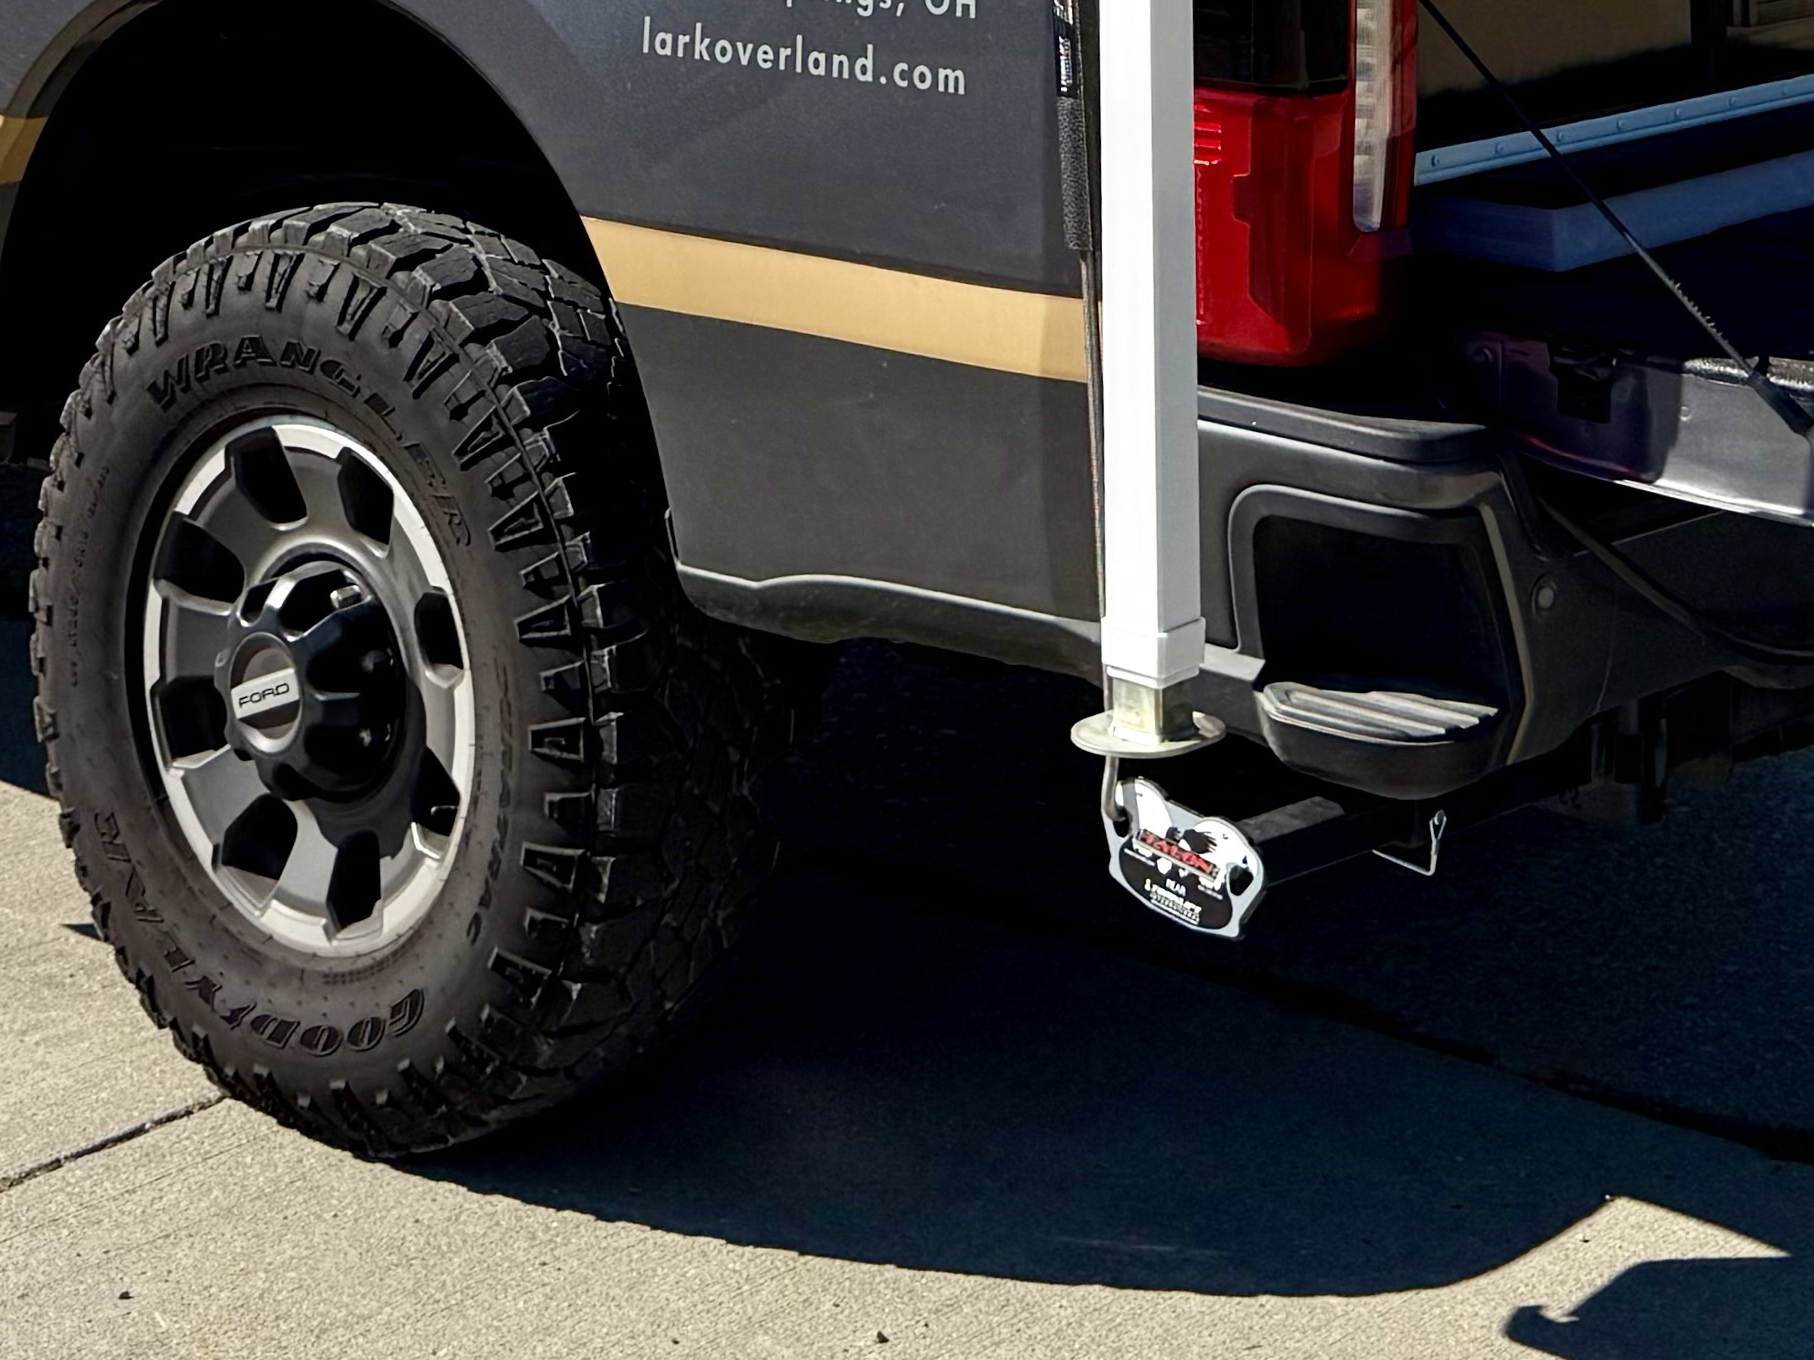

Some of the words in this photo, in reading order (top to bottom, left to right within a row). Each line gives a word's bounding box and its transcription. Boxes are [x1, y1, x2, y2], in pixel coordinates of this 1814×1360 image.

[642, 15, 967, 95] larkoverland.com
[145, 333, 473, 548] WRANGLER
[238, 682, 290, 708] FORD
